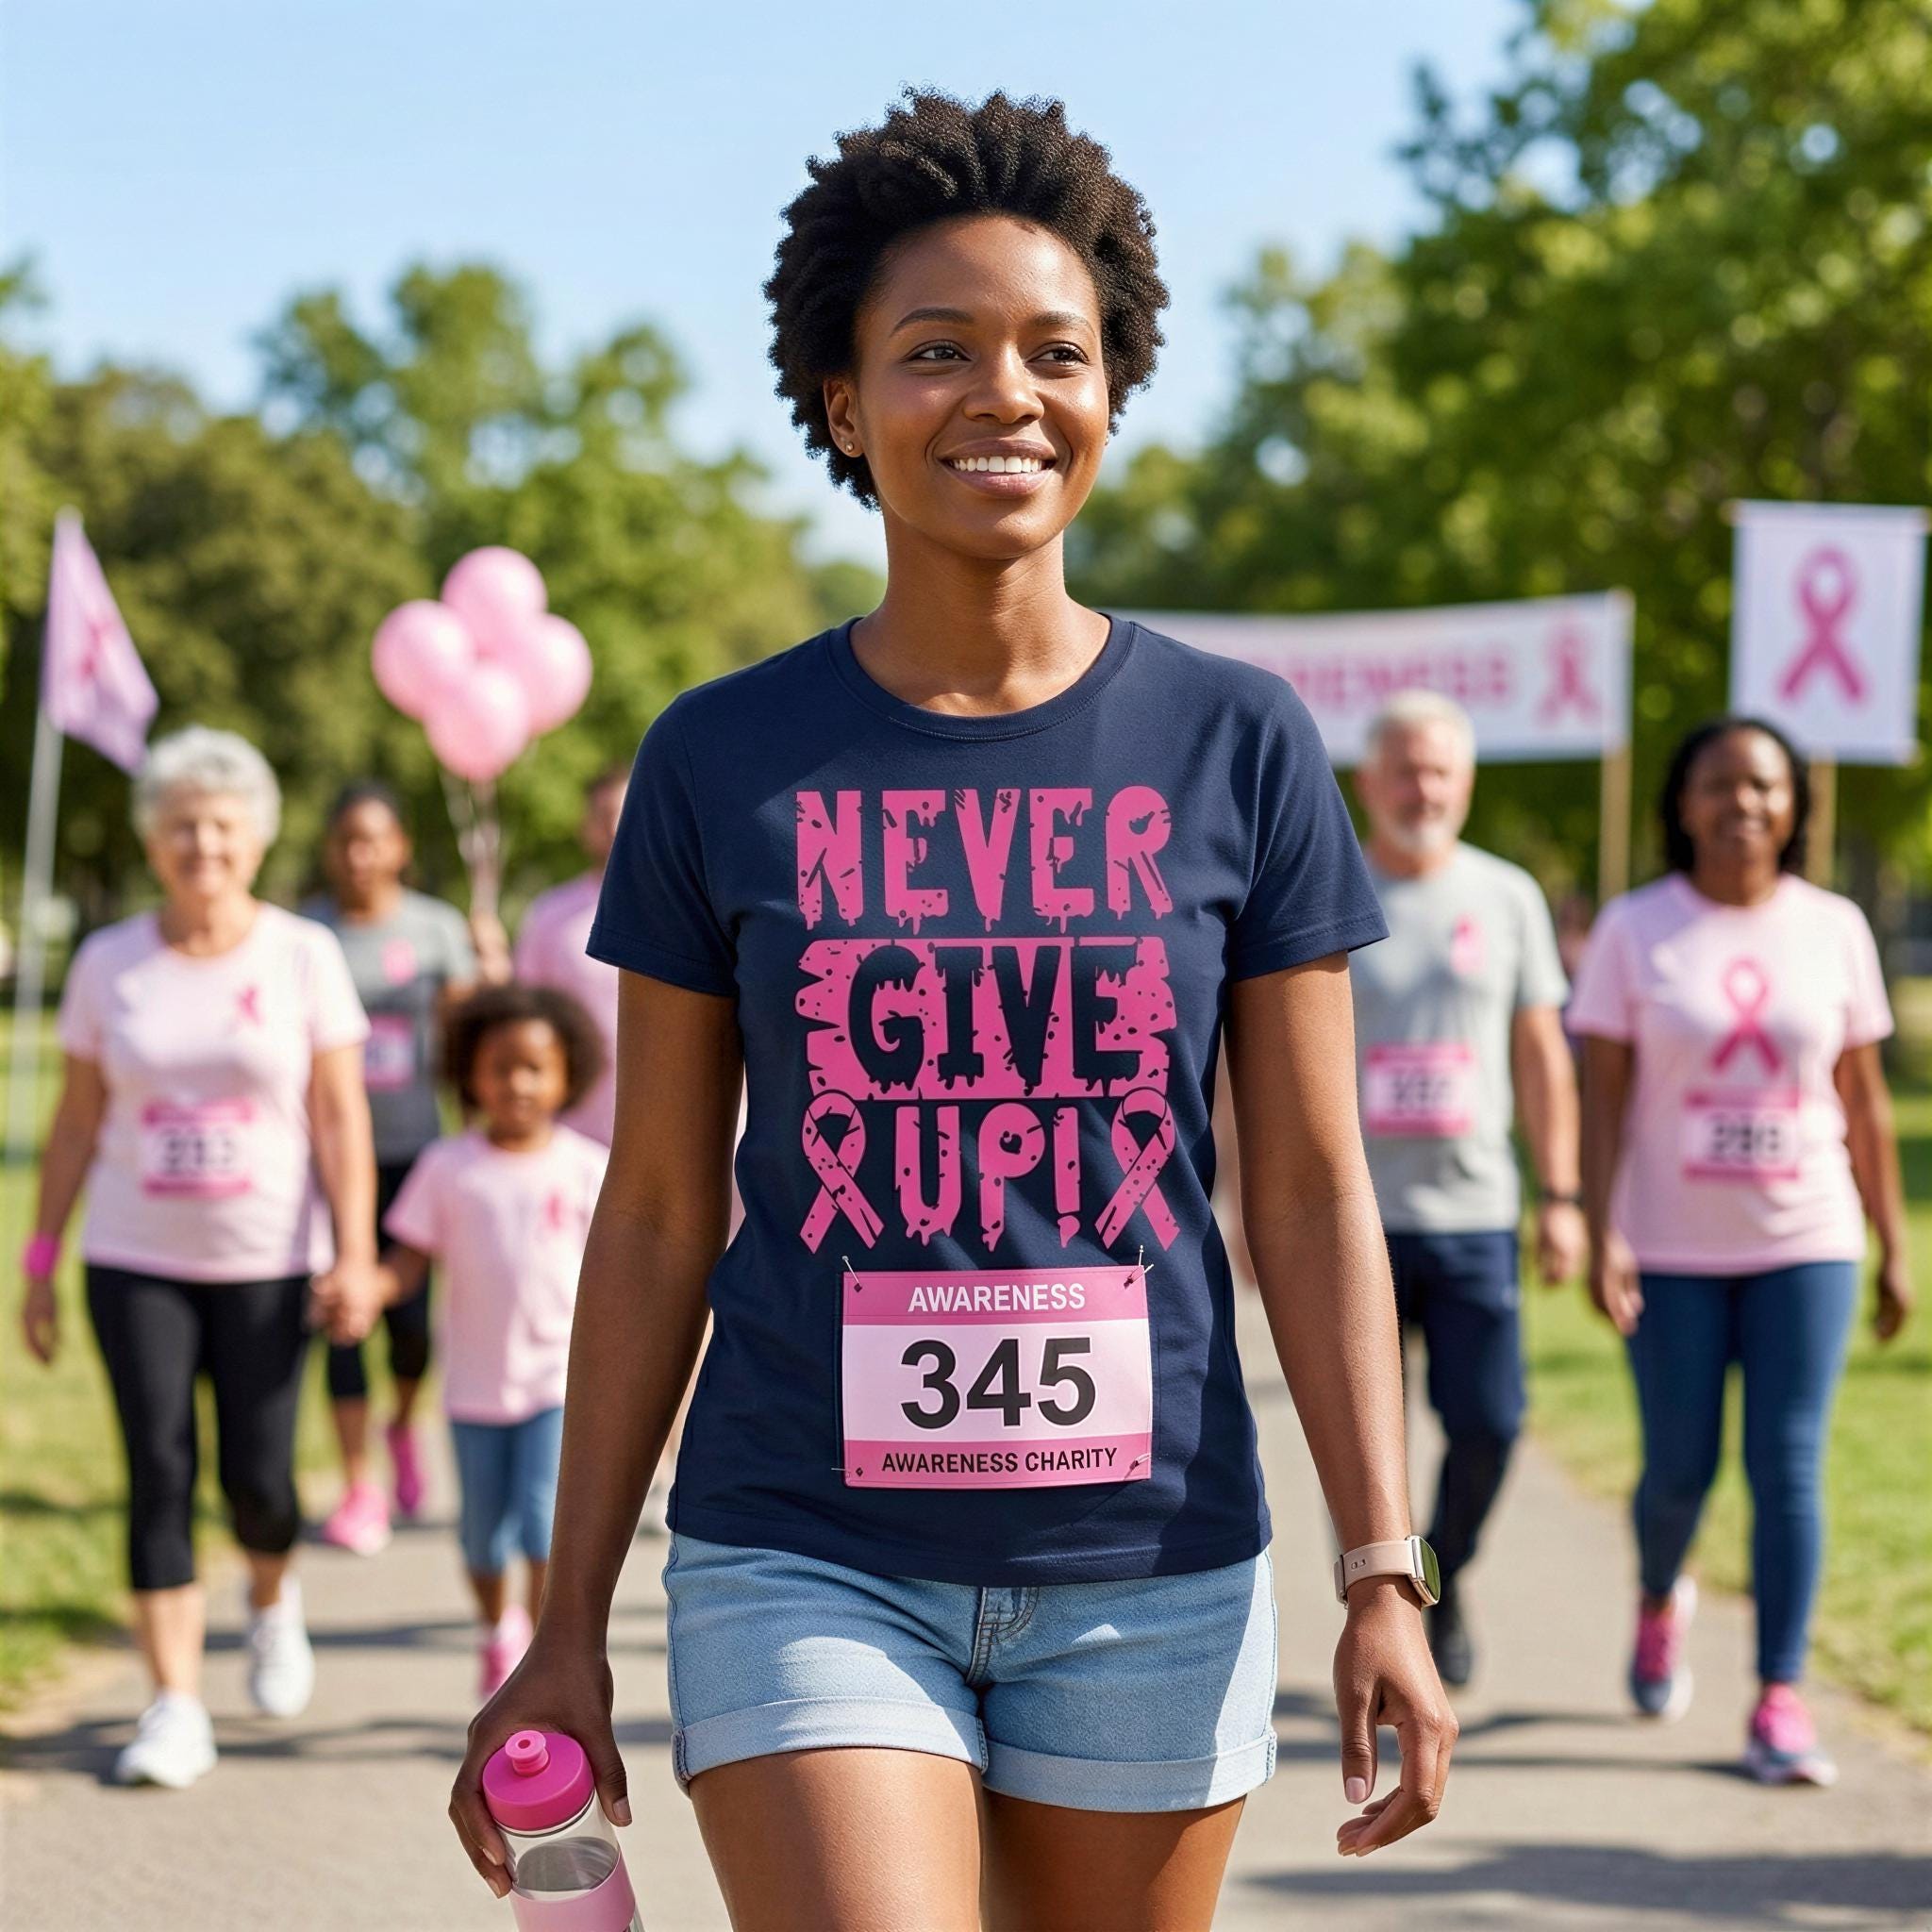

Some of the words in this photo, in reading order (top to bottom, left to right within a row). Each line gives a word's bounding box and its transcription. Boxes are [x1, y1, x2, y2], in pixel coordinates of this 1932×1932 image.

[796, 785, 1174, 934] NEVER
[849, 944, 1141, 1095] GIVE
[895, 1102, 1081, 1252] UP!
[908, 1282, 1086, 1313] AWARENESS
[900, 1336, 1097, 1430] 345
[881, 1452, 1019, 1474] AWARENESS
[1024, 1446, 1119, 1474] CHARITY
